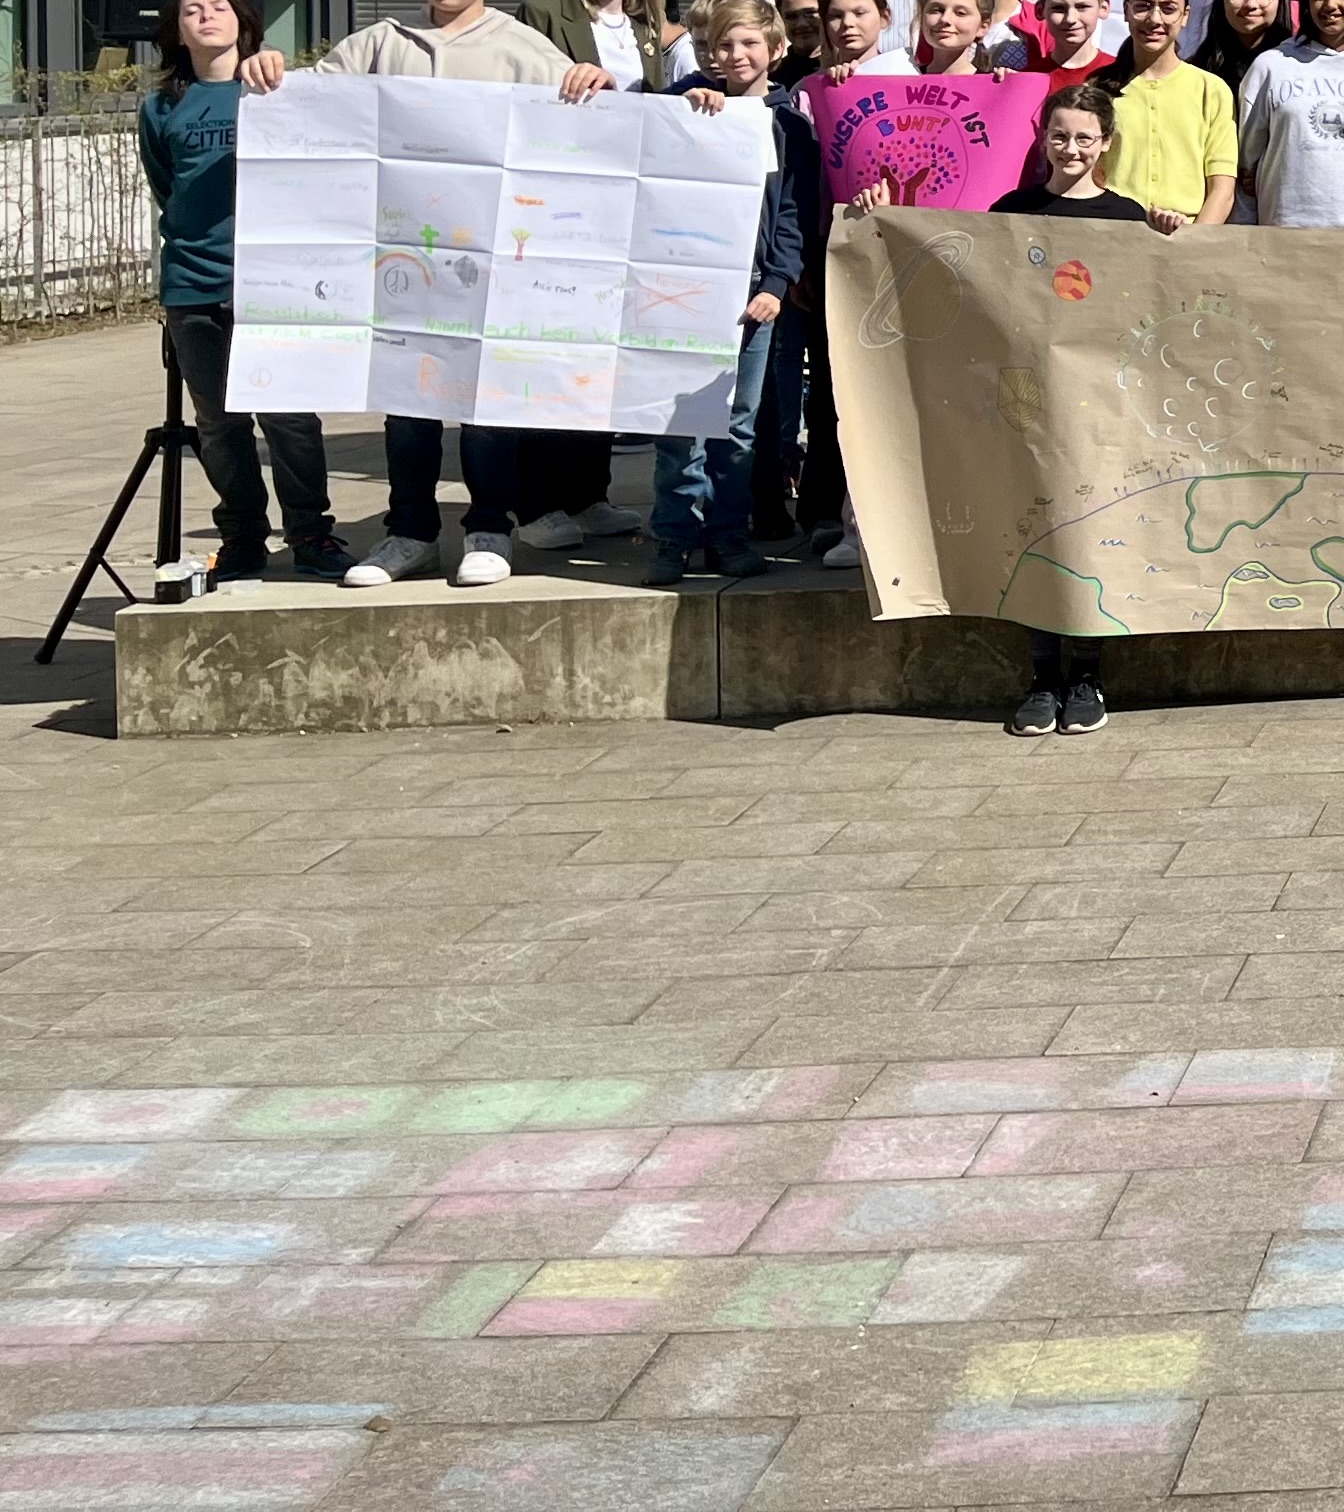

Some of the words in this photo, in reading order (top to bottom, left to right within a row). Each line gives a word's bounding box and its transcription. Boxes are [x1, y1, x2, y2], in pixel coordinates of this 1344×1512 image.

[828, 91, 889, 169] UNSERE
[905, 83, 970, 110] WELT
[960, 111, 990, 148] IST
[876, 114, 950, 137] BUNT!
